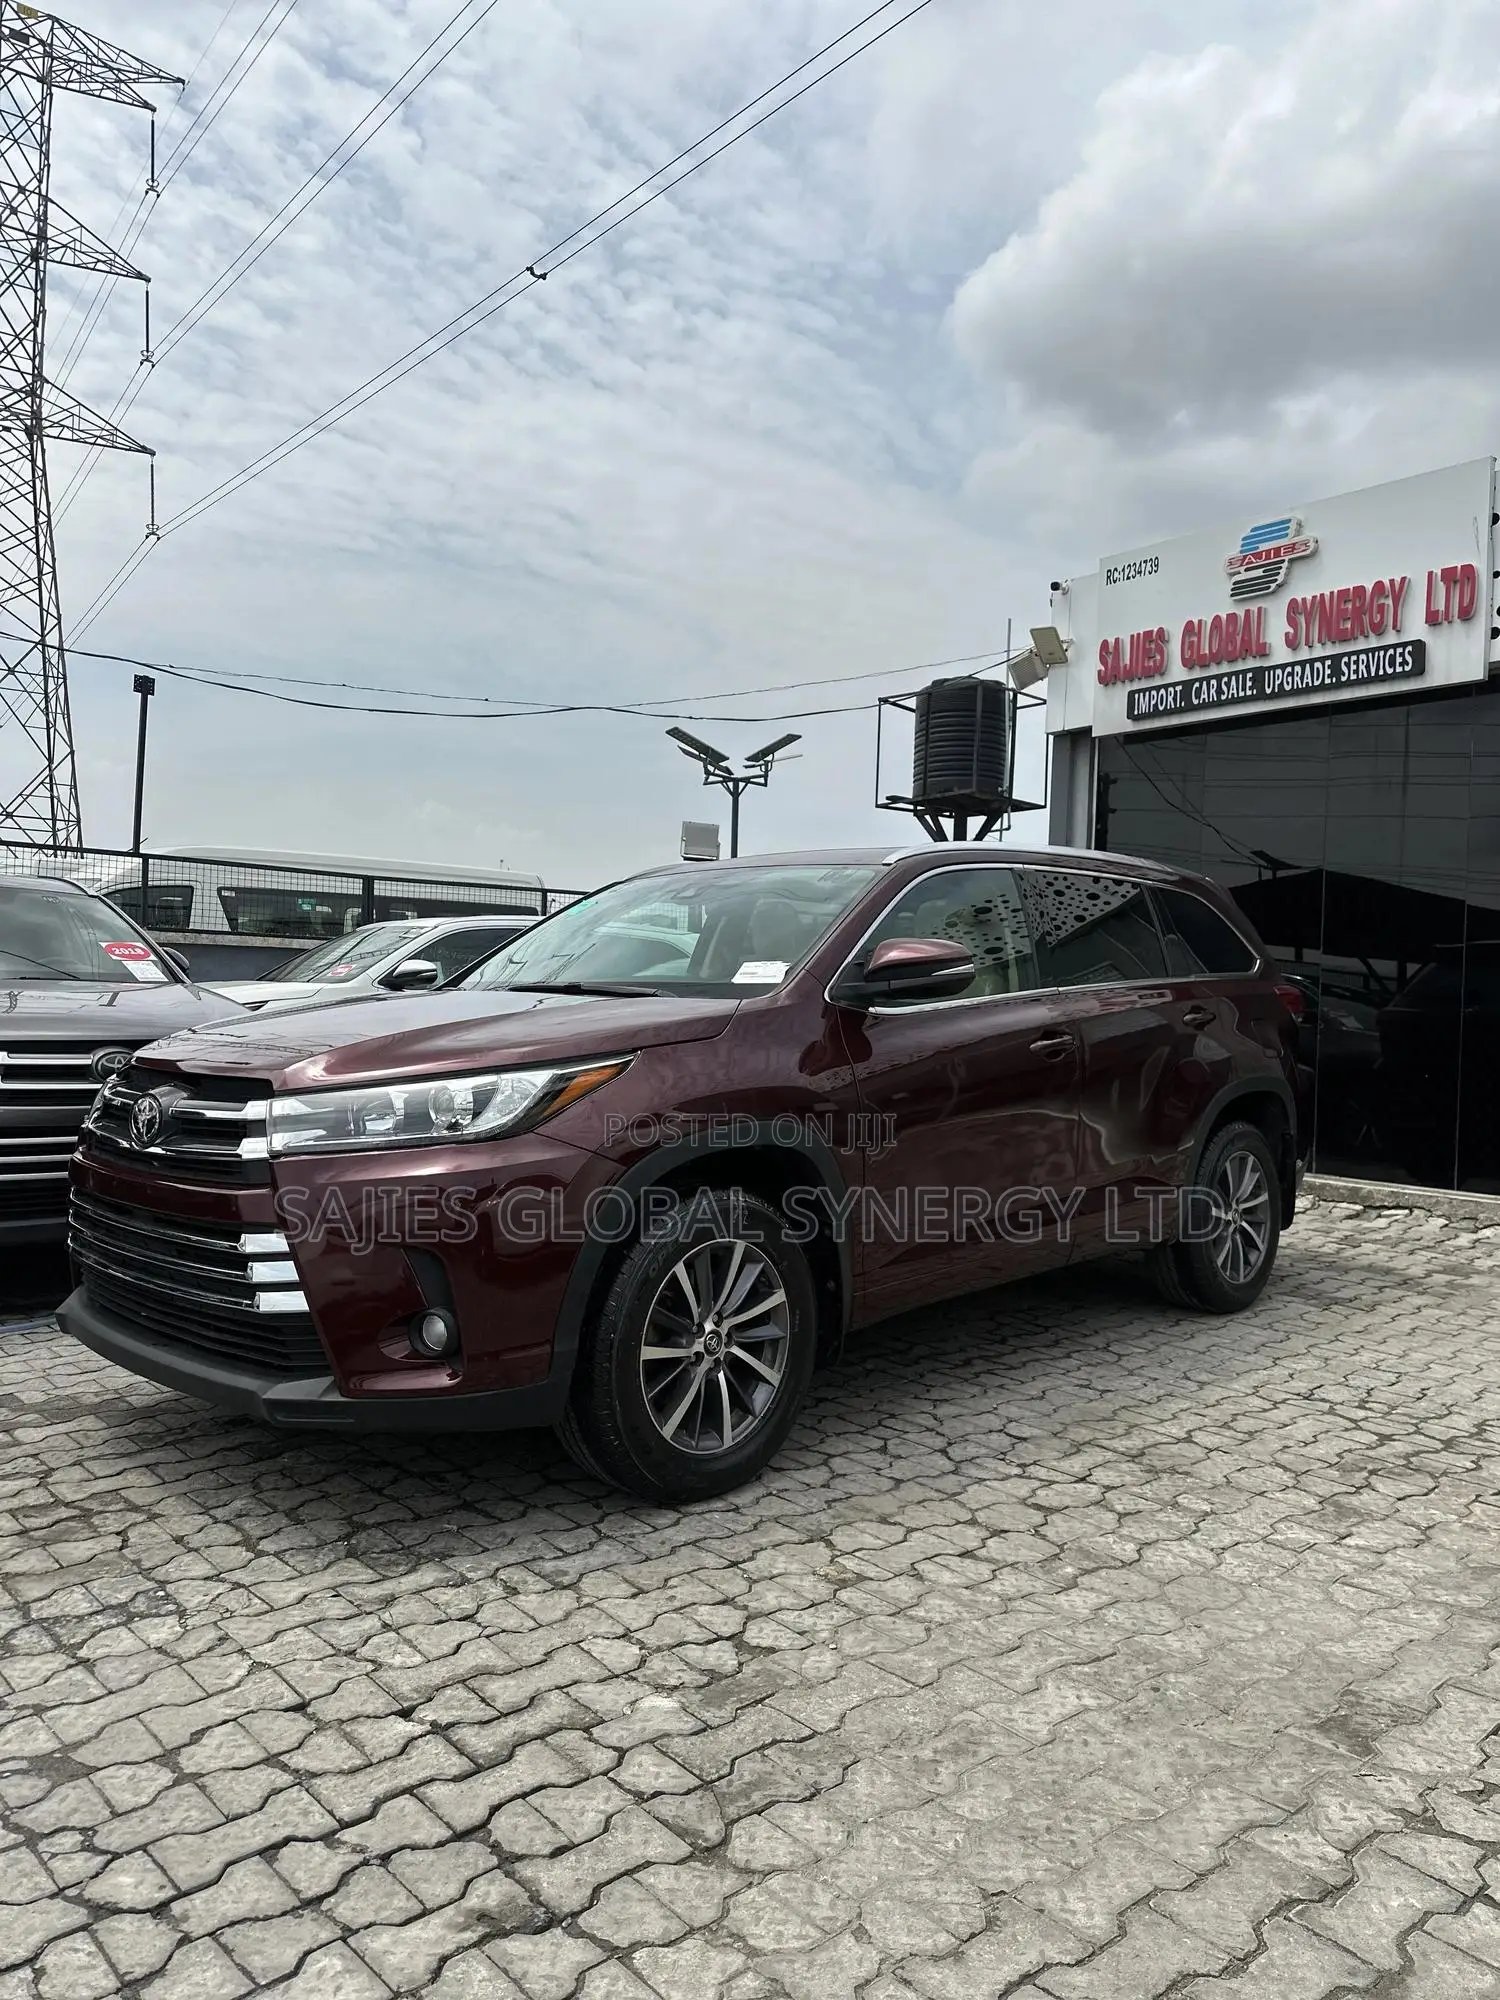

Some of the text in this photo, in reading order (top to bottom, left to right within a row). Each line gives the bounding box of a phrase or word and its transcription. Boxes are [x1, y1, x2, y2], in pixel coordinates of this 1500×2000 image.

[1225, 539, 1310, 570] SAJIES
[1106, 556, 1160, 586] RC:1234739
[1097, 563, 1479, 686] SAJIES GLOBAL SYNERGY LTD
[1133, 645, 1414, 715] IMPORT. CAR SALE. UPGRADE. SERVICES
[111, 946, 145, 956] 2018
